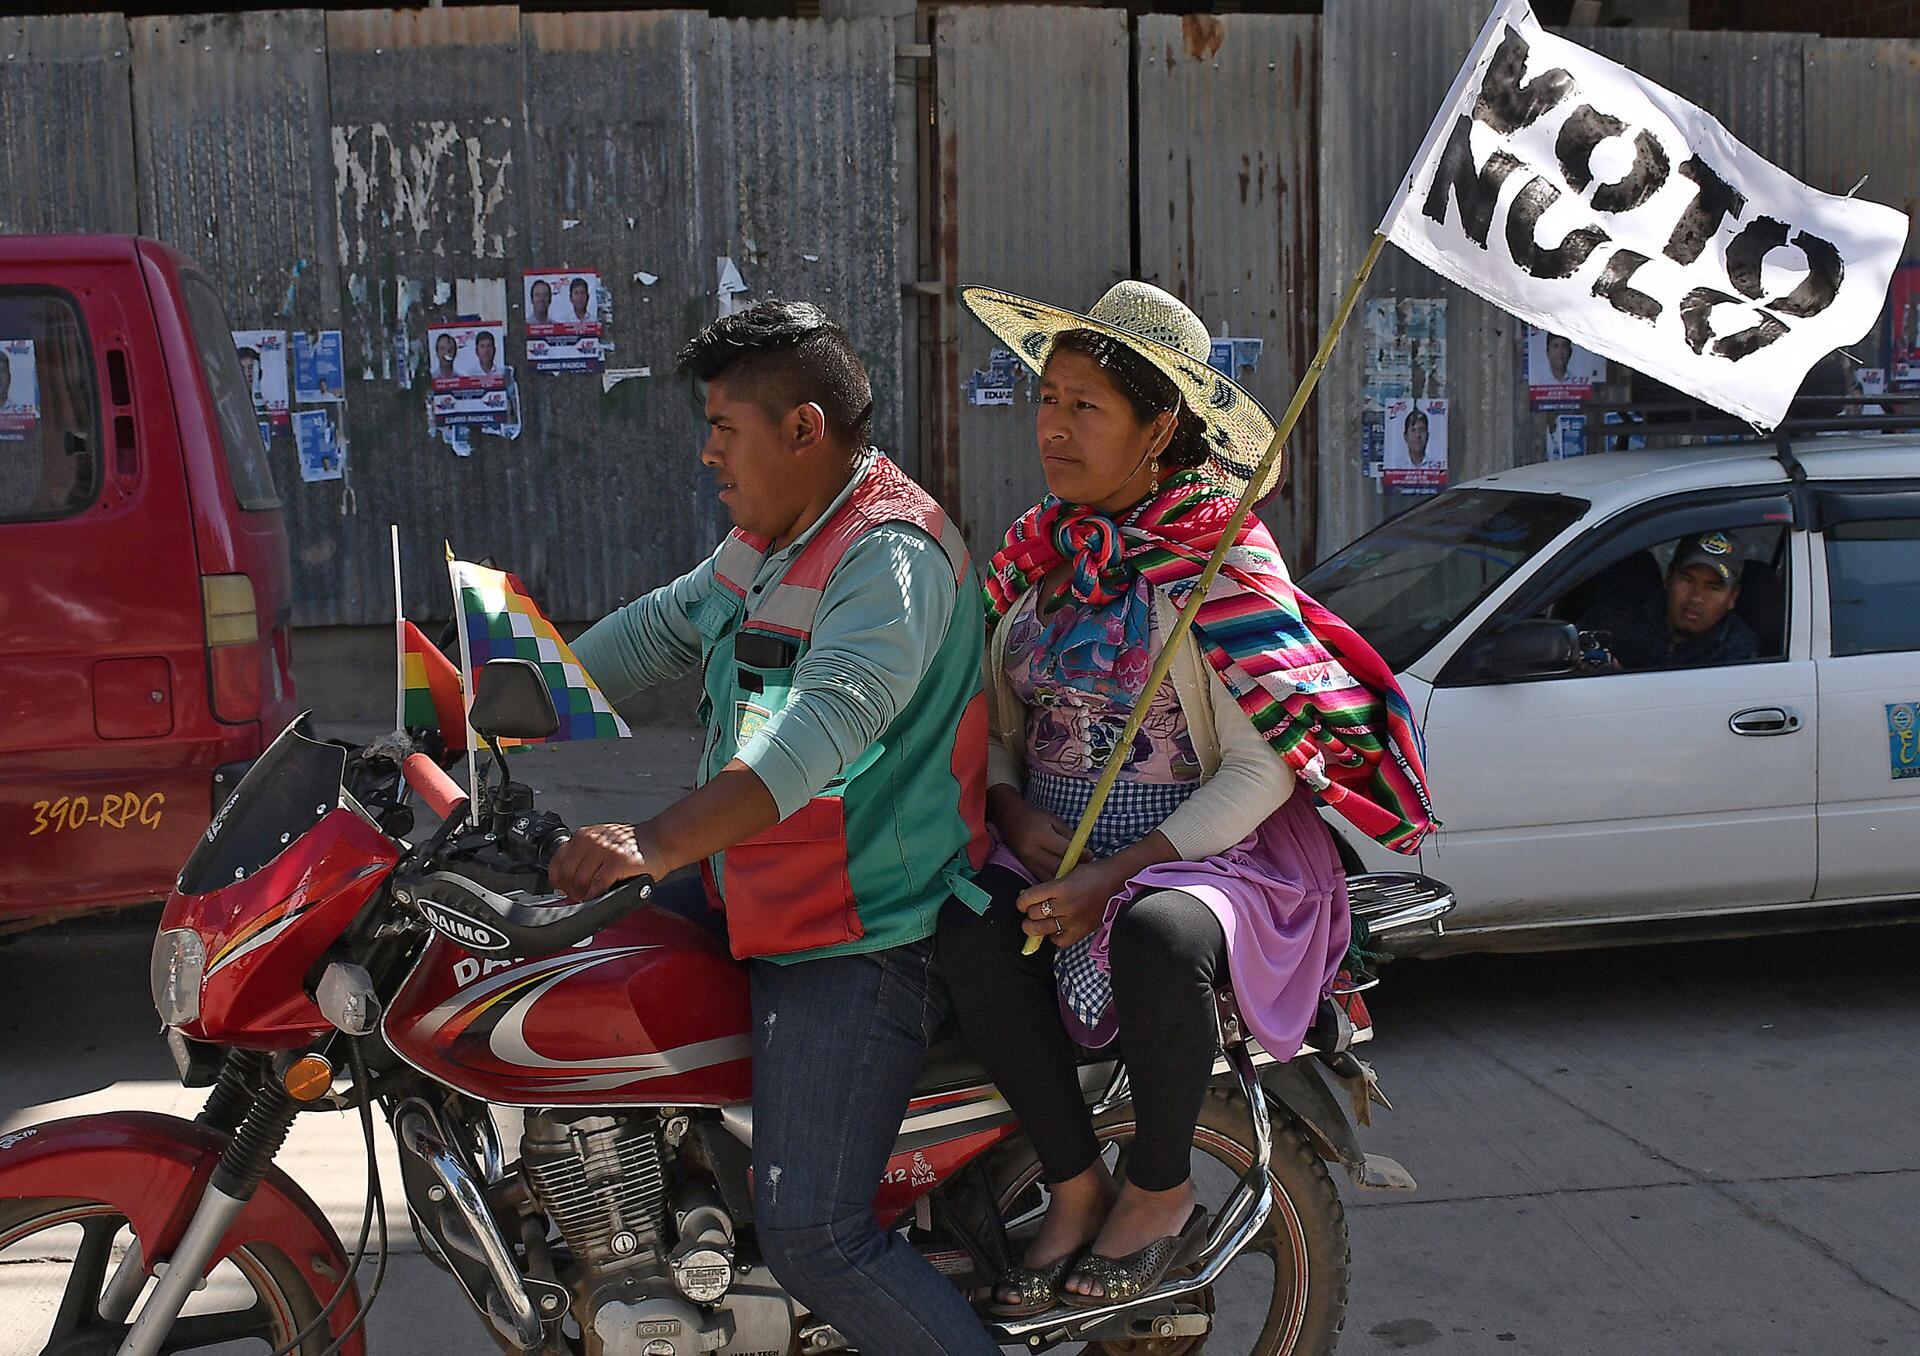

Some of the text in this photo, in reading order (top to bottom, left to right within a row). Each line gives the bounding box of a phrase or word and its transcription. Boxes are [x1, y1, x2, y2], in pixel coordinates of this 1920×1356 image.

[1472, 24, 1845, 318] VOTO
[1422, 114, 1790, 362] NULO
[29, 792, 165, 835] 390-RPG
[425, 905, 491, 945] DAIMO
[880, 1168, 907, 1184] 12
[641, 1322, 676, 1335] CDI
